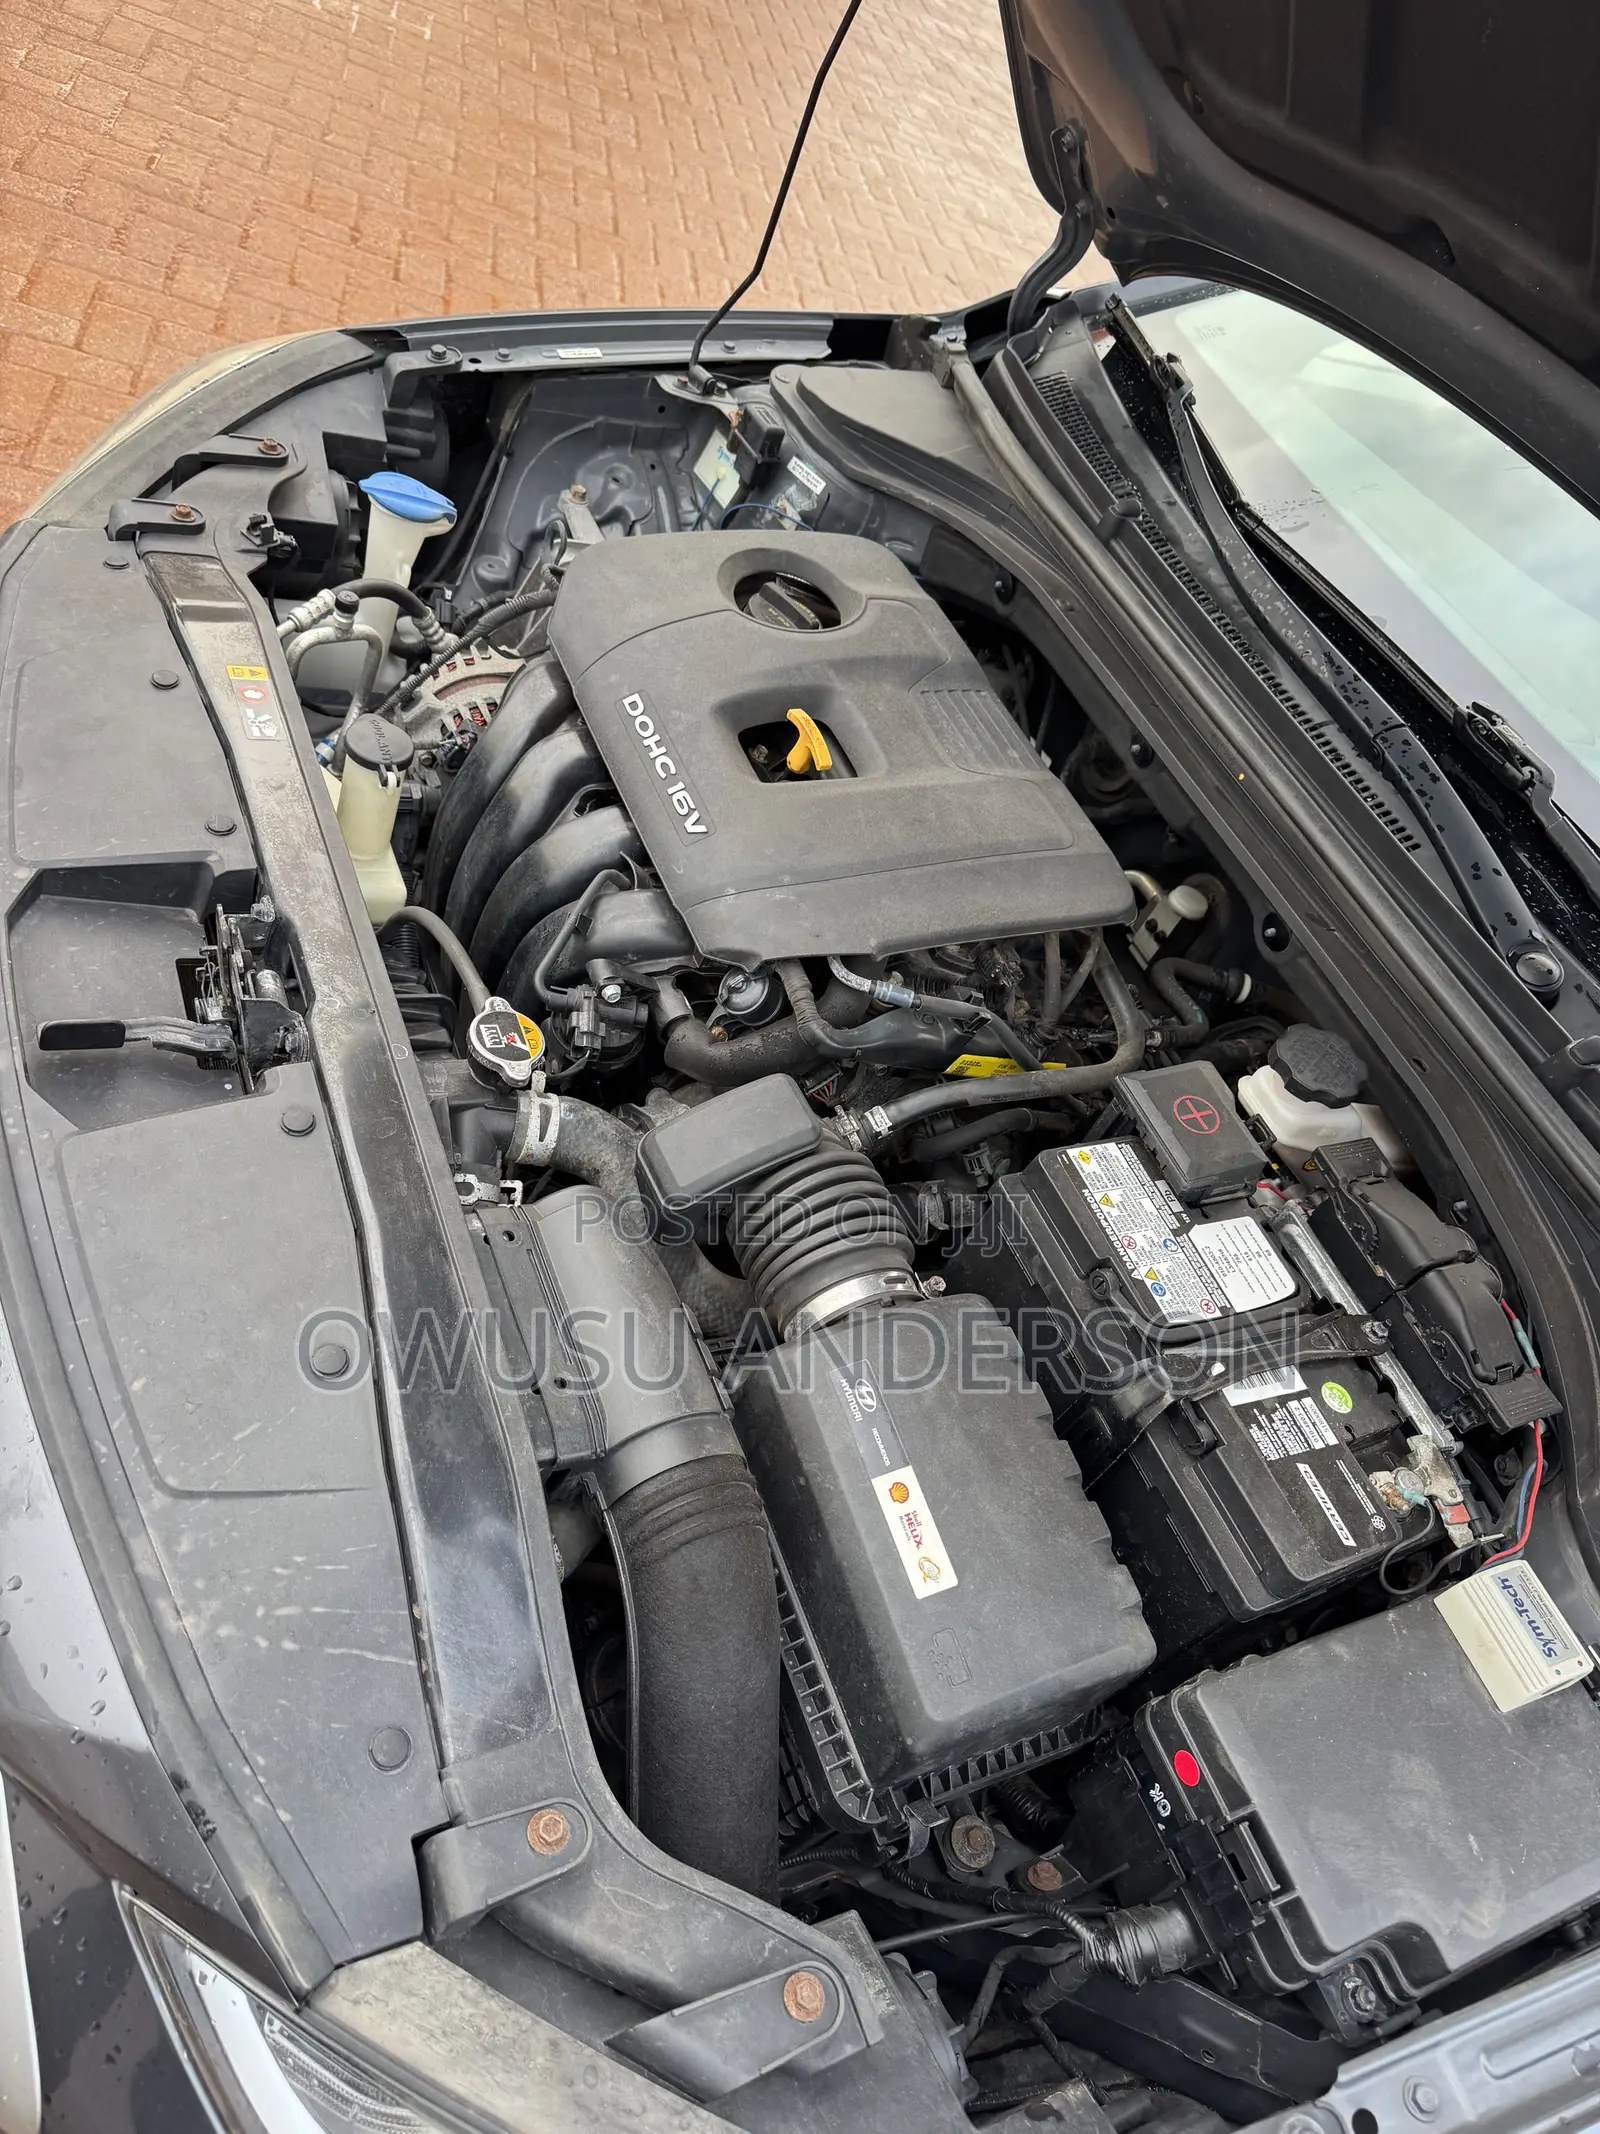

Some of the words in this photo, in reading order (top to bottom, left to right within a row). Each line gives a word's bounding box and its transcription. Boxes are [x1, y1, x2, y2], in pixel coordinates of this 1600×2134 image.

[369, 718, 392, 764] COOLANT
[621, 691, 678, 781] DOHC
[666, 781, 708, 837] 16V
[1162, 1189, 1175, 1202] Pb
[1081, 1188, 1135, 1269] DANGER/POISON
[839, 1378, 862, 1422] HYUNDAI
[910, 1509, 922, 1527] Shell
[1301, 1469, 1351, 1540] CERTIFIED
[903, 1511, 925, 1550] HELIX
[1498, 1577, 1557, 1657] Sym-Tech
